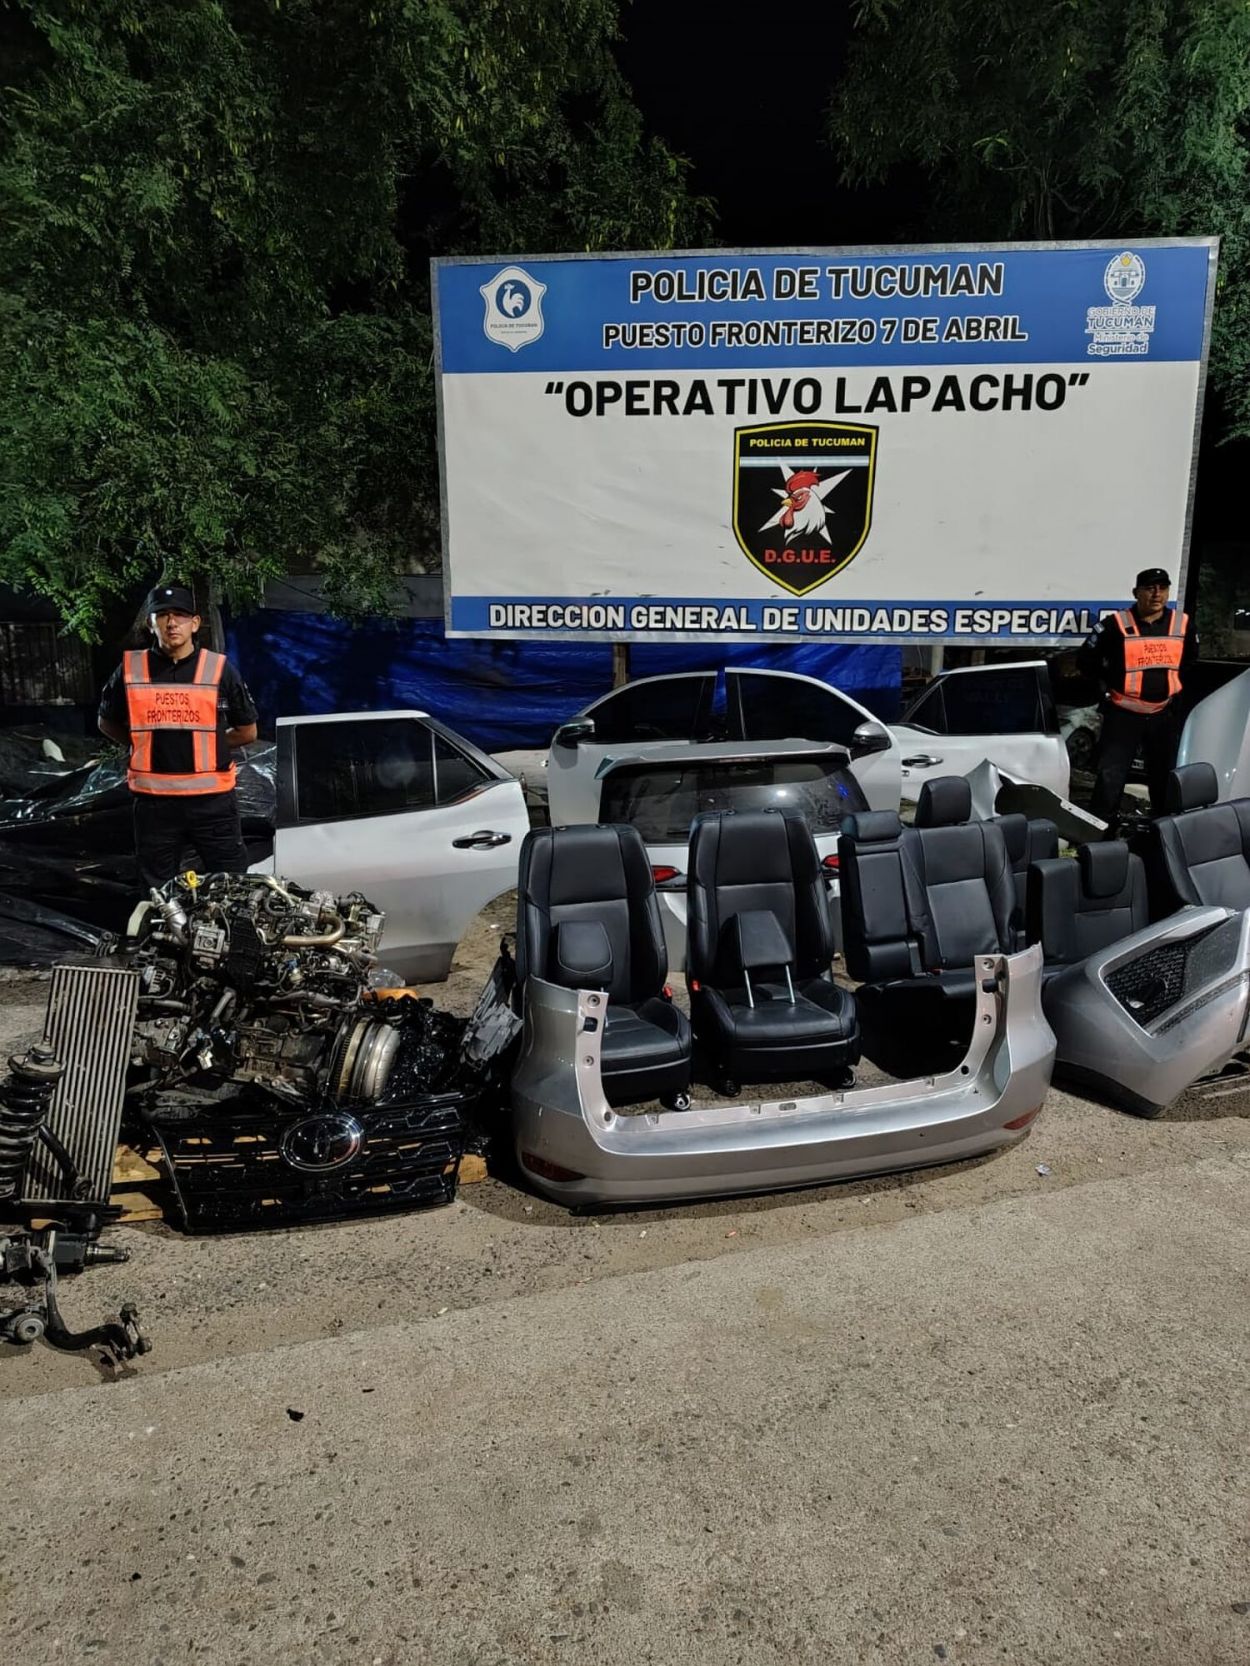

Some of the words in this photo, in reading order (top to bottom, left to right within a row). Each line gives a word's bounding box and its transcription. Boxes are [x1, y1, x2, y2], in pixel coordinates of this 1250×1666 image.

[630, 269, 766, 303] POLICIA
[773, 266, 821, 301] DE
[826, 263, 1004, 299] TUCUMAN
[603, 322, 705, 349] PUESTO
[709, 319, 876, 347] FRONTERIZO
[881, 319, 899, 343] 7
[902, 317, 939, 343] DE
[943, 315, 1028, 342] ABRIL
[1087, 343, 1149, 356] Seguridad
[750, 439, 791, 447] POLICIA
[811, 438, 865, 446] TUCUMAN
[764, 549, 836, 563] D.G.U.E.
[488, 604, 625, 629] DIRECCION
[630, 607, 756, 630] GENERAL
[762, 608, 798, 631] DE
[805, 608, 948, 632] UNIDADES
[155, 692, 190, 705] PUESTOS
[147, 709, 201, 723] FRONTERIZOS
